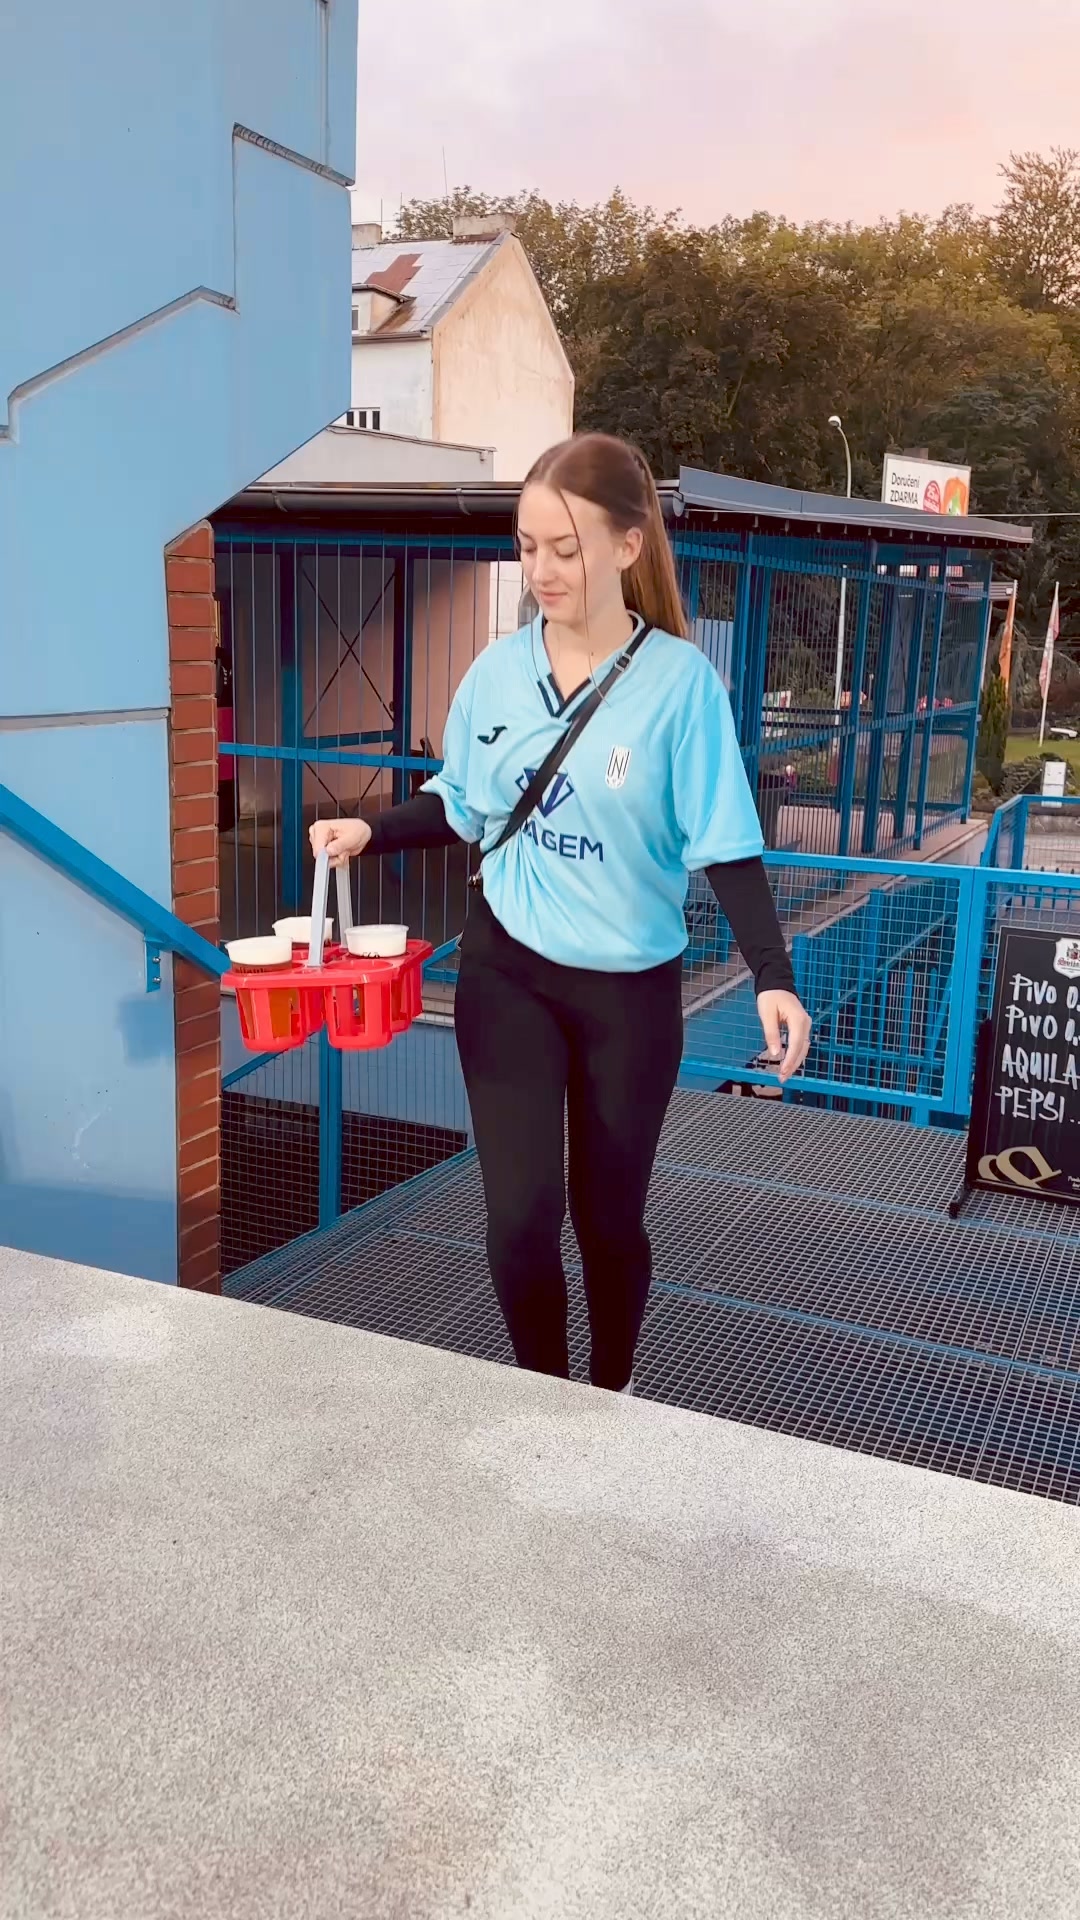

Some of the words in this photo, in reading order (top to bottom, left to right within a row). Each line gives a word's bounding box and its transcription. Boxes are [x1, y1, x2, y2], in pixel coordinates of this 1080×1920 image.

[891, 472, 921, 488] Doručení
[890, 489, 919, 505] ZDARMA
[522, 819, 604, 862] AGEM
[1001, 1043, 1080, 1090] AQUILA
